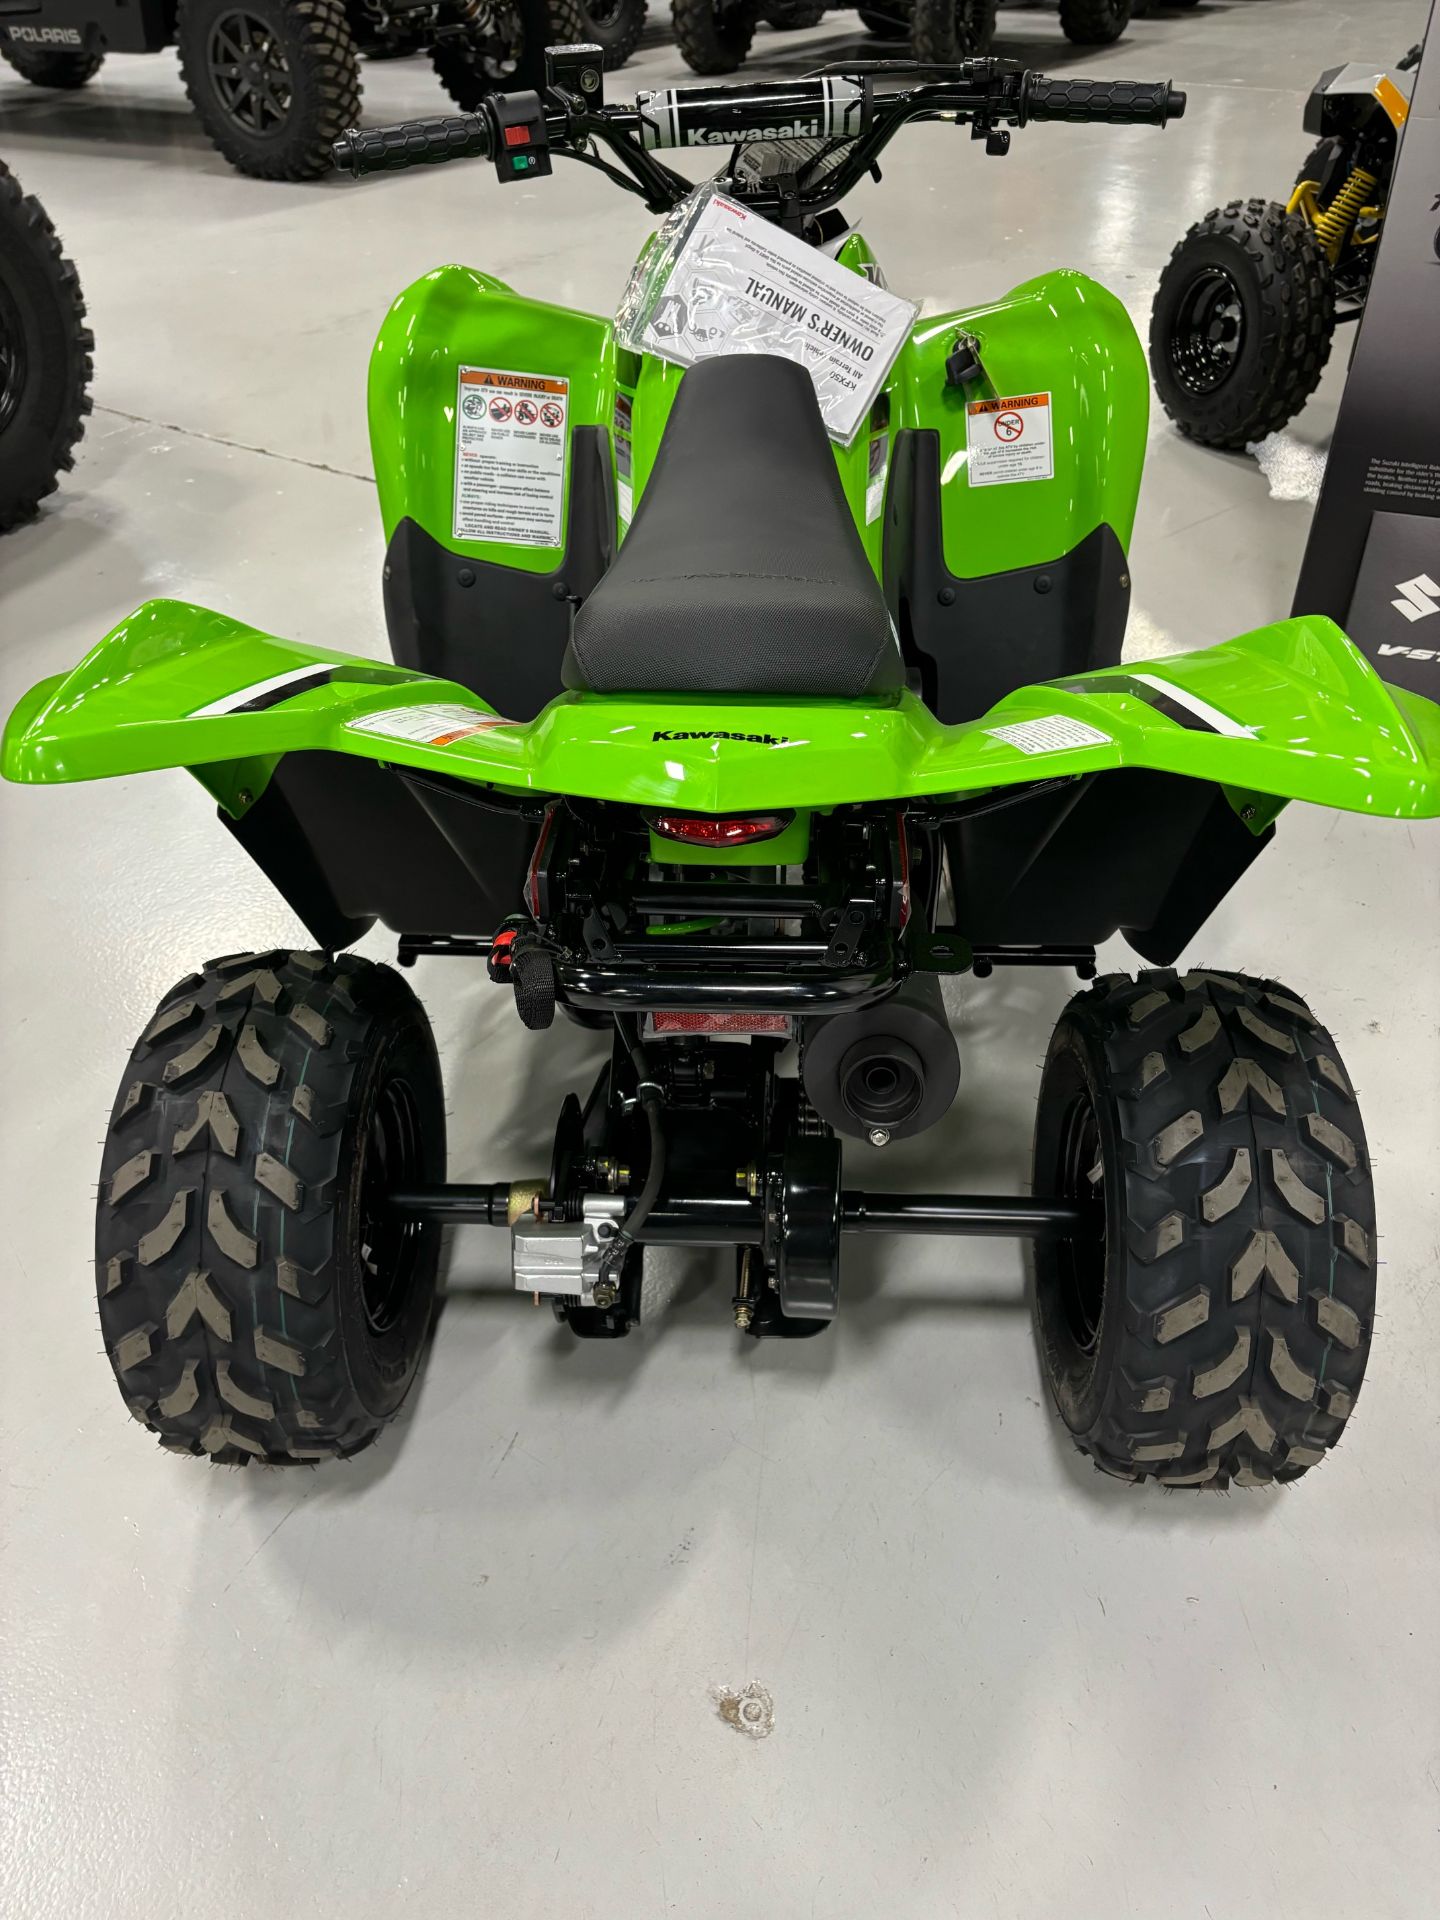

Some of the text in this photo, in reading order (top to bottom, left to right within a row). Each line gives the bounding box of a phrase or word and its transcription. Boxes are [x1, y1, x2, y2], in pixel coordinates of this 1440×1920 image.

[9, 26, 81, 44] POLARIS
[687, 118, 818, 146] Kawasaki
[713, 199, 747, 221] Kawasaki
[745, 276, 808, 322] MANUAL
[808, 313, 874, 362] OWNER'S
[497, 375, 545, 390] WARNING
[829, 370, 858, 390] KFX50
[852, 369, 863, 380] All
[991, 397, 1039, 410] WARNING
[1006, 427, 1012, 436] 6
[652, 731, 789, 745] Kawasaki
